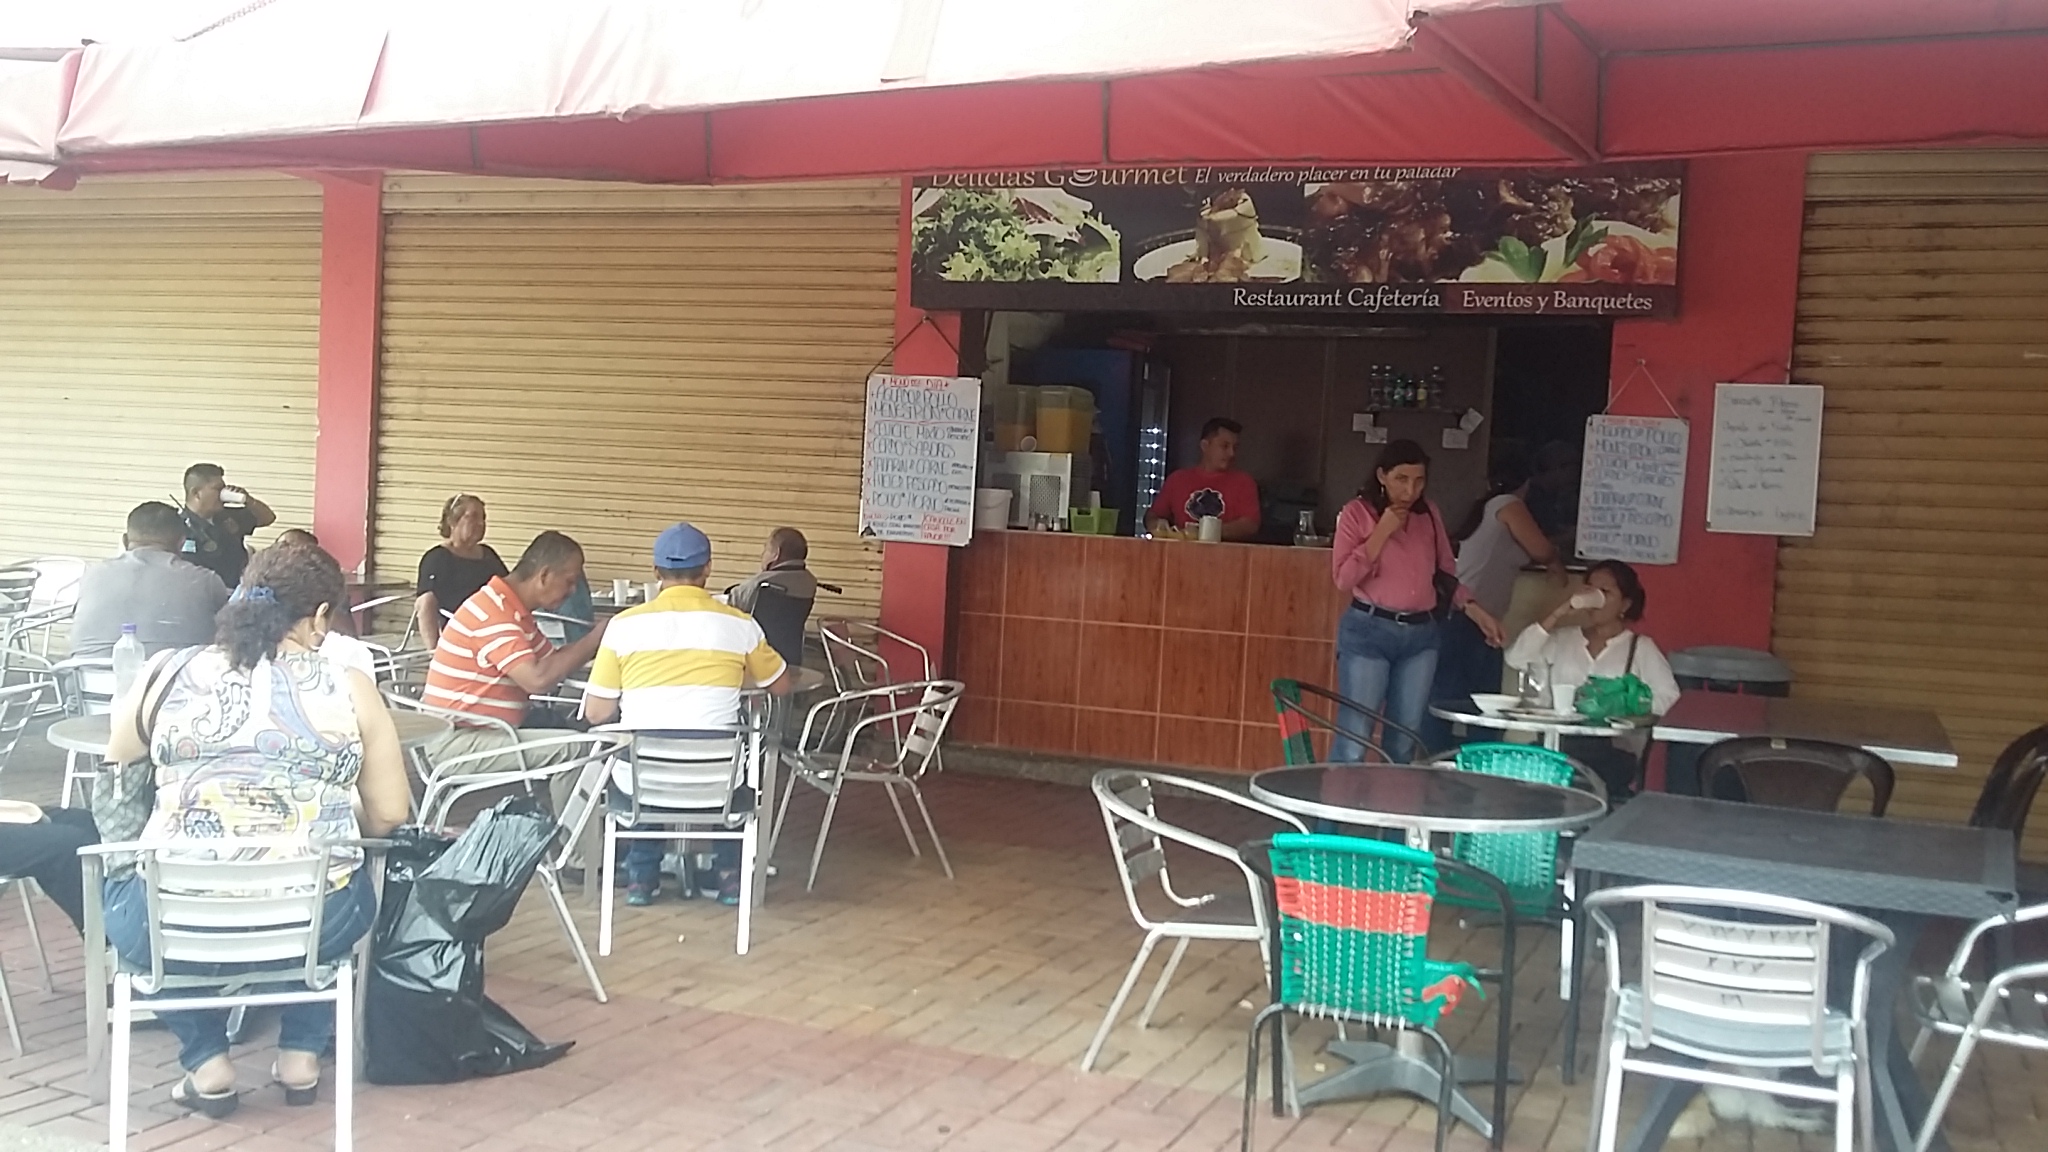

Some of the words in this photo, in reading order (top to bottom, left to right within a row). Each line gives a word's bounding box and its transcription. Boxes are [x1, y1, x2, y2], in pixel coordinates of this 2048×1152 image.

[1194, 166, 1212, 184] El
[1217, 166, 1295, 183] verdadero
[1297, 166, 1347, 186] placer
[1349, 169, 1369, 180] en
[1374, 167, 1394, 180] tu
[1394, 166, 1461, 183] paladar
[1233, 287, 1343, 307] Restaurant
[1347, 285, 1442, 313] Cafetería
[1462, 290, 1533, 308] Eventos
[1535, 295, 1549, 314] y
[1553, 290, 1653, 314] Banquetes
